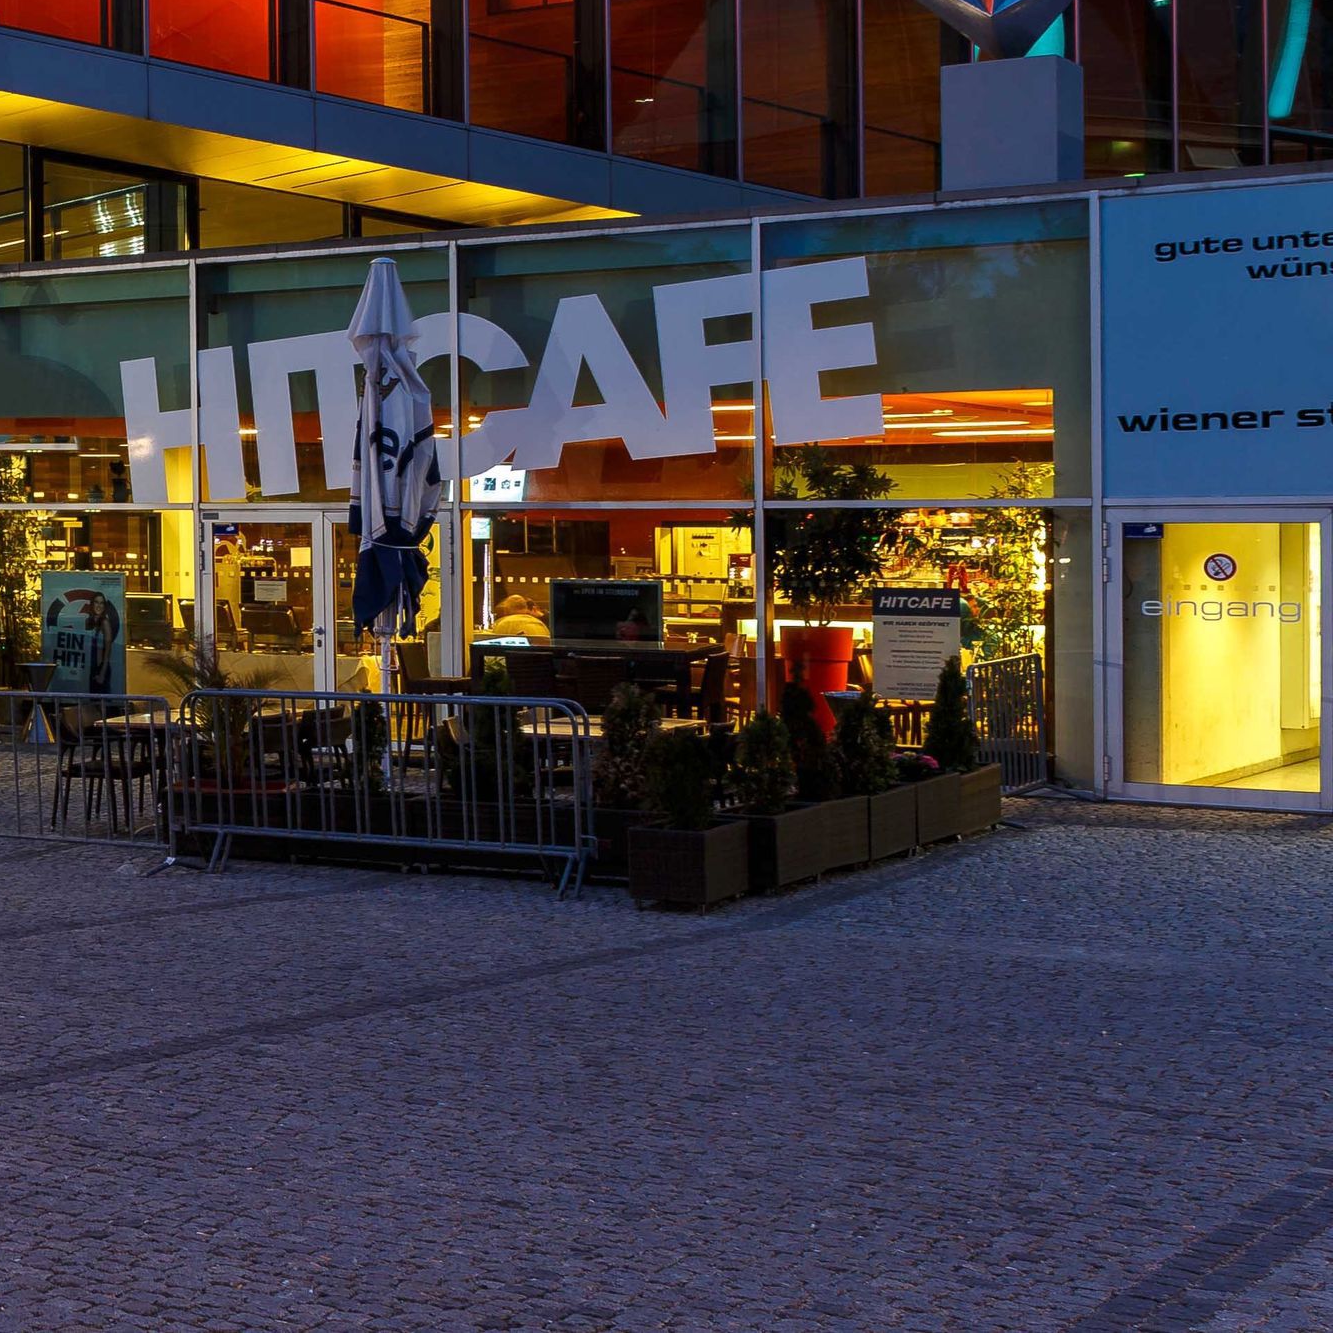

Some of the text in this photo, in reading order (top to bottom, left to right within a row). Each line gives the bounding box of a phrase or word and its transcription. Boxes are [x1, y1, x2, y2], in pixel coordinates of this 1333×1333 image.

[1154, 236, 1244, 263] gute
[1246, 256, 1333, 280] wün
[1117, 407, 1285, 433] wiener
[879, 596, 953, 609] HITCAFE
[1141, 595, 1301, 623] eingang
[57, 631, 85, 650] EIN
[53, 649, 86, 668] HIT!
